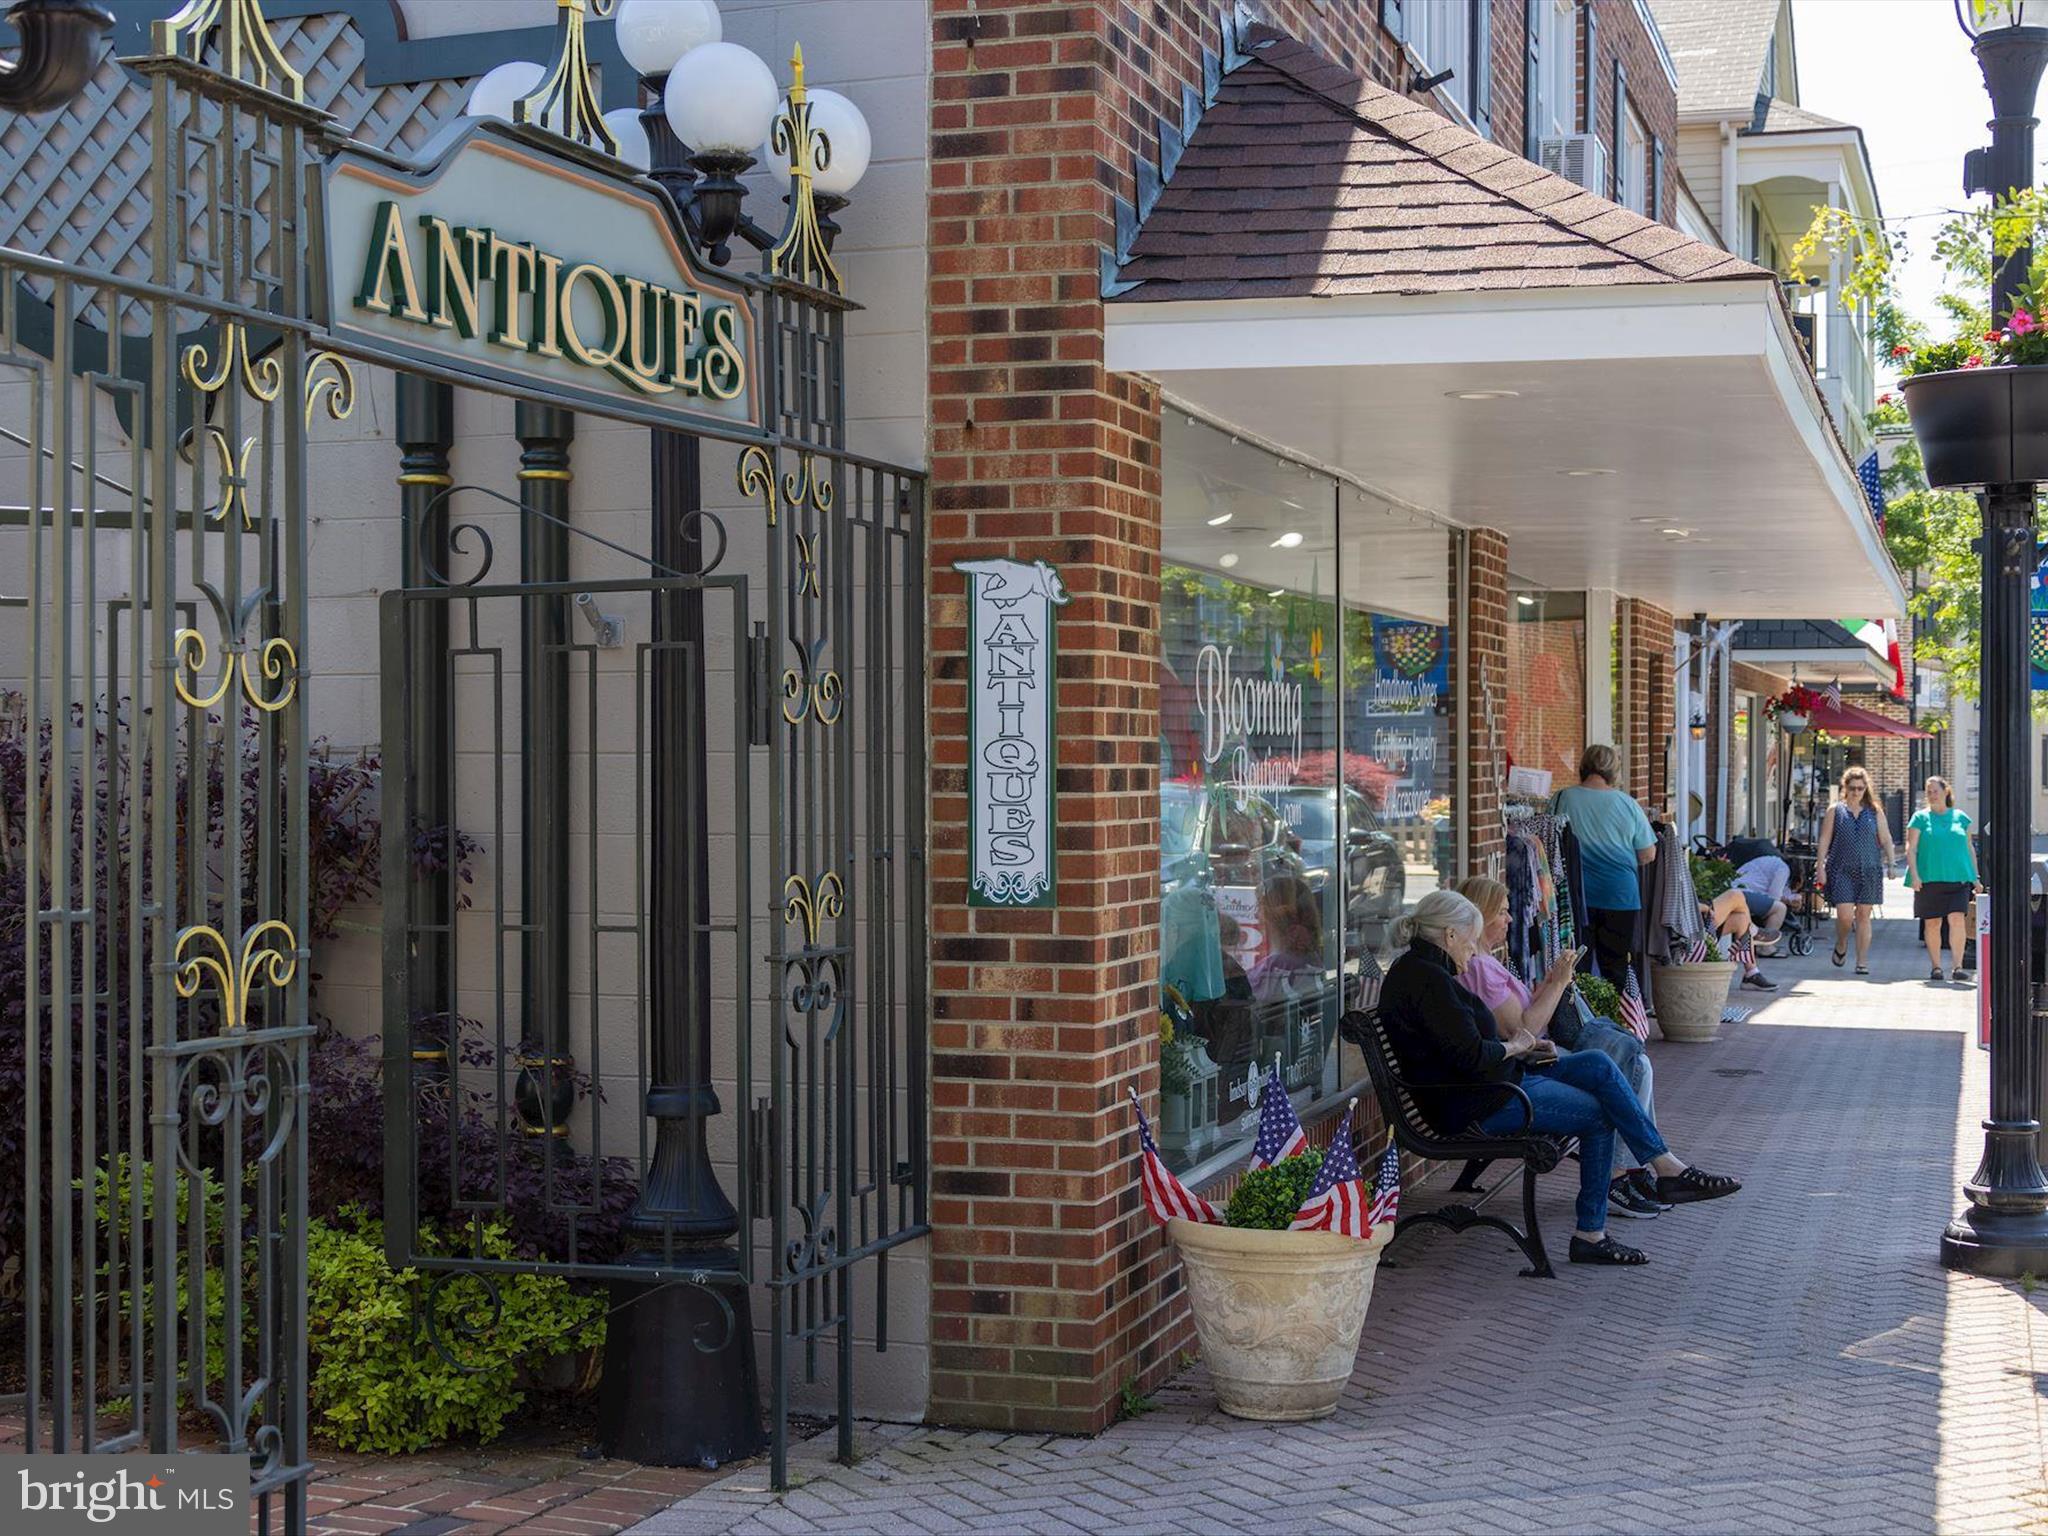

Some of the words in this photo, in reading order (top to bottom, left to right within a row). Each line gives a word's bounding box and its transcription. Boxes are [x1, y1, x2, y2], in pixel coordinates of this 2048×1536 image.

[354, 201, 746, 400] ANTIQUES
[984, 614, 1040, 866] ANTIQUES
[1196, 645, 1303, 775] Blooming
